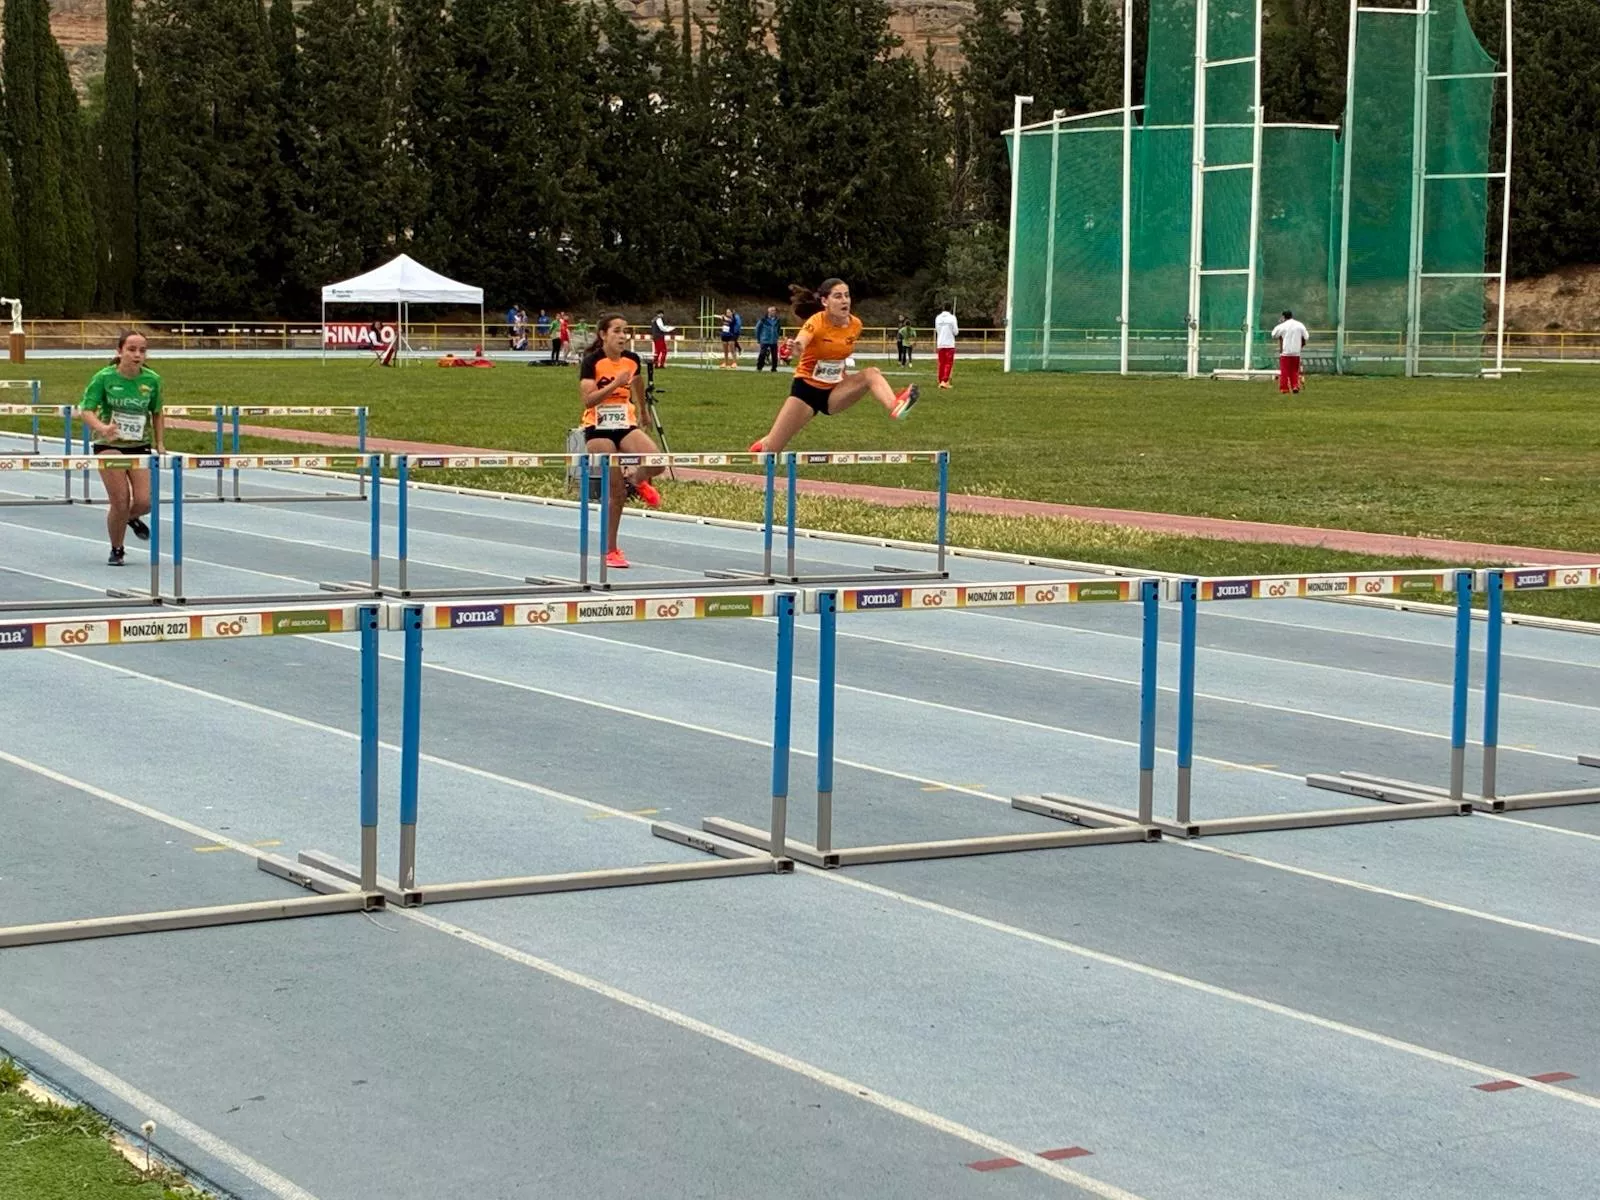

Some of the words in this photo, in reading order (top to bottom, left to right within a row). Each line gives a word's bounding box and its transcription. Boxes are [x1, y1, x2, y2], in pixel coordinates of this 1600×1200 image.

[324, 325, 395, 343] HINAO
[603, 413, 626, 421] 1792
[1564, 574, 1580, 585] GO
[1269, 585, 1287, 596] GO
[1365, 582, 1382, 593] GO
[922, 594, 943, 606] GO
[967, 591, 998, 602] MONZÓN
[999, 591, 1016, 601] 2021
[1035, 590, 1055, 602] GO
[527, 610, 551, 624] GO
[579, 606, 614, 618] MONZÓN
[616, 605, 634, 616] 2021
[657, 605, 680, 618] GO
[123, 621, 165, 637] MONZÓN
[167, 623, 188, 635] 2021
[216, 621, 243, 636] GO
[60, 628, 89, 644] GO
